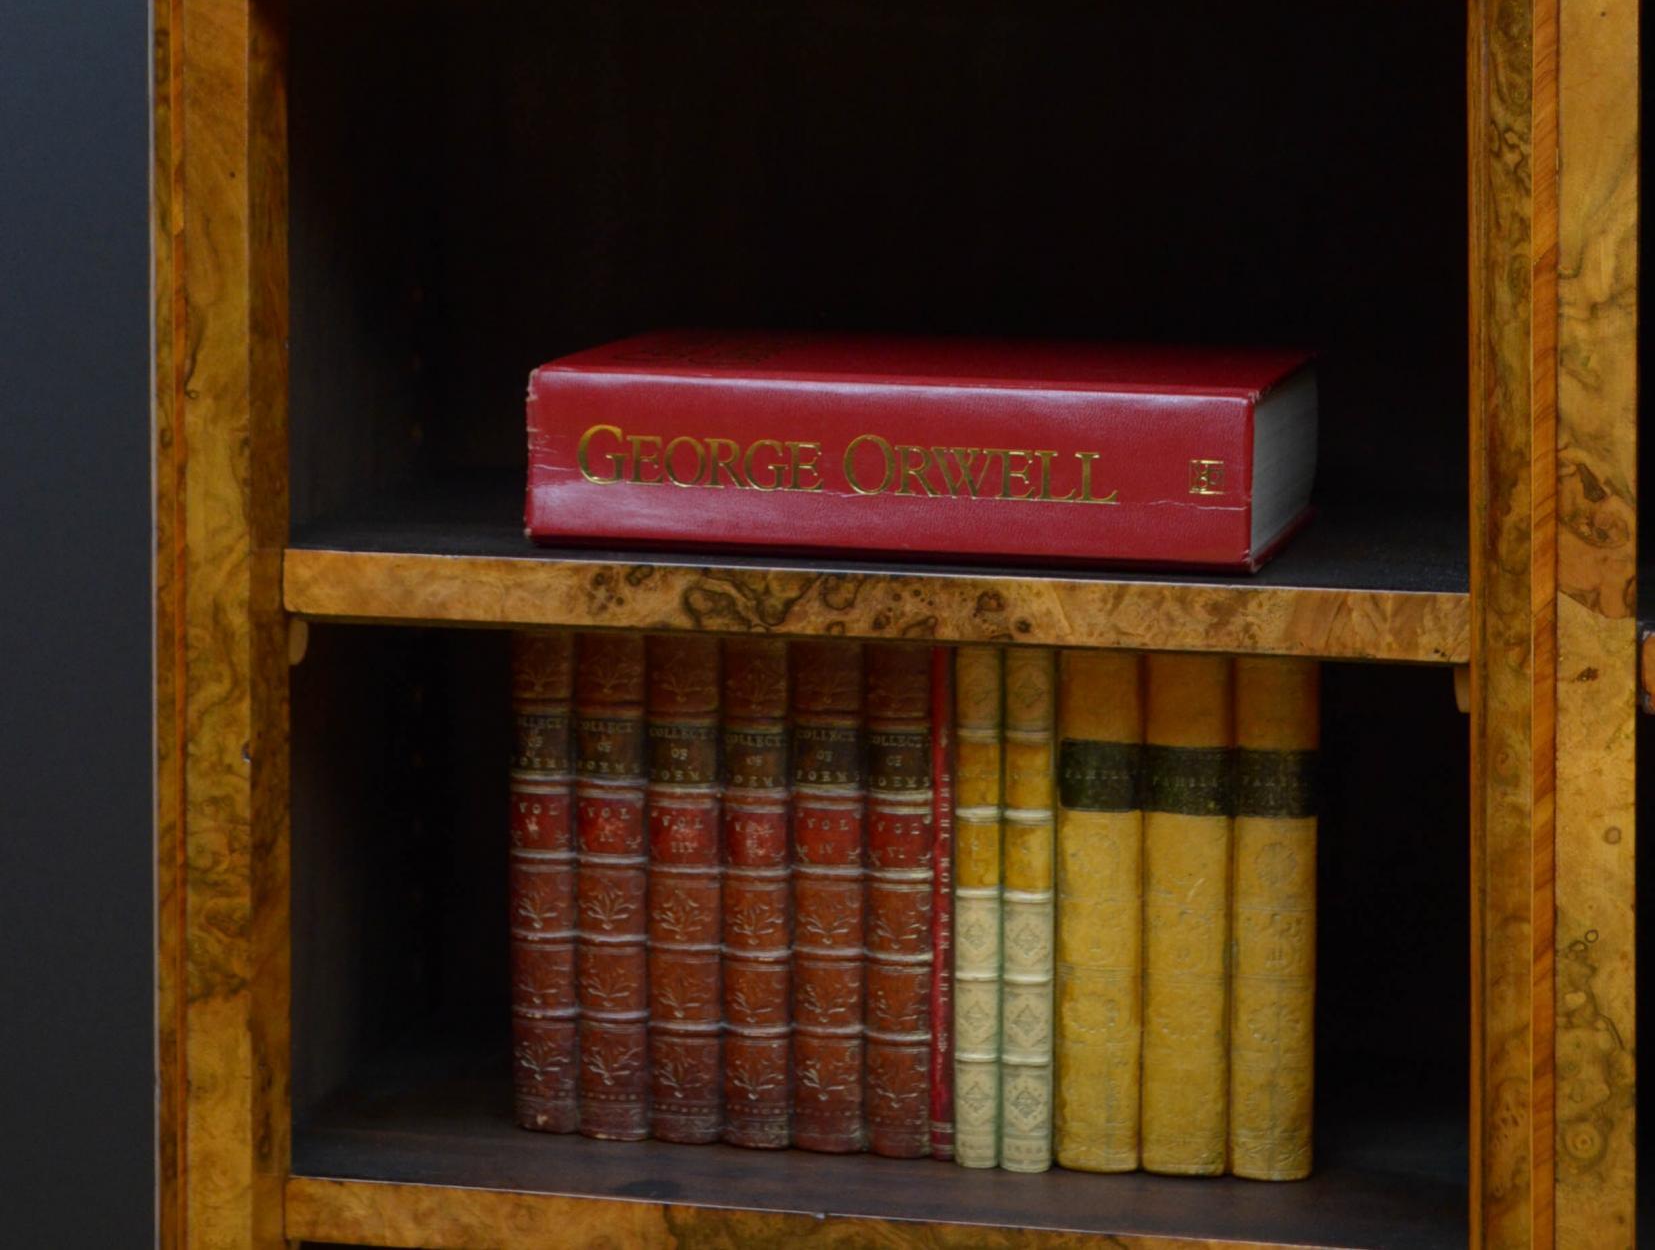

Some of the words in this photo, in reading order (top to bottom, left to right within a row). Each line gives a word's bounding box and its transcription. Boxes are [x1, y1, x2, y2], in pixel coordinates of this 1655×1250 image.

[577, 424, 824, 492] GEORGE
[843, 434, 1121, 506] ORWELL
[587, 806, 631, 820] VOL
[807, 818, 850, 831] VOL
[939, 857, 951, 895] TOM
[939, 912, 951, 950] NEW
